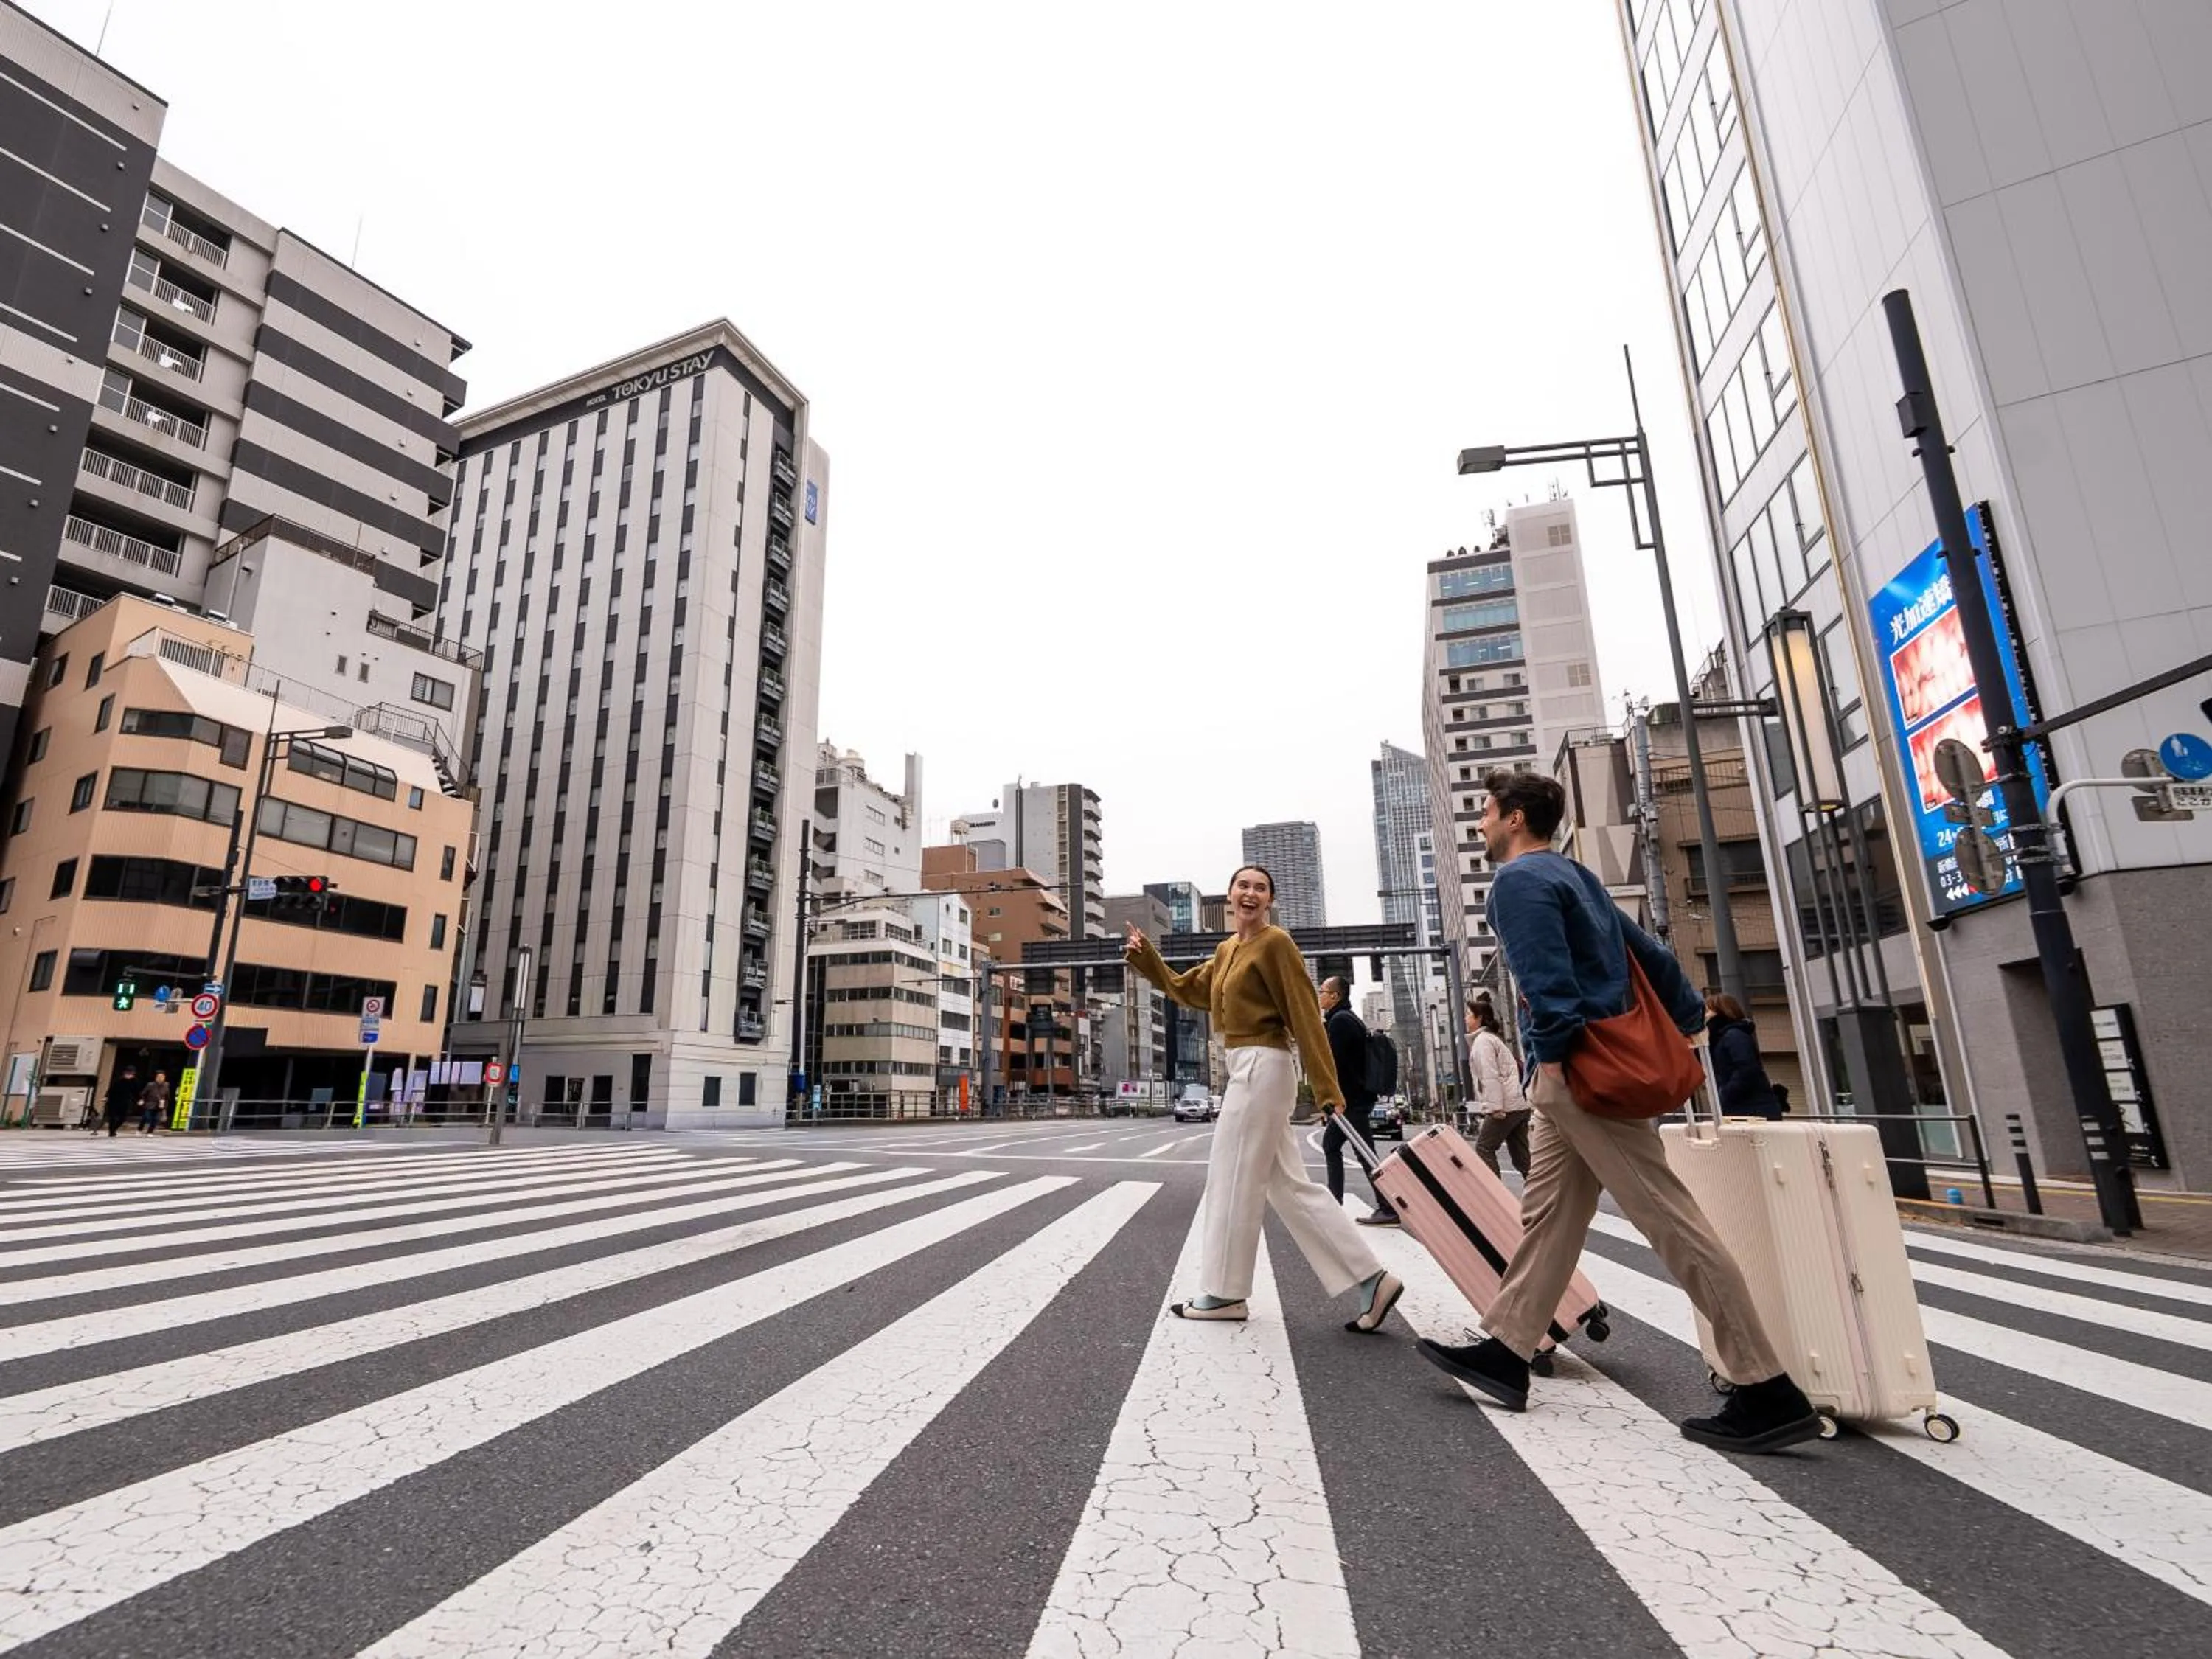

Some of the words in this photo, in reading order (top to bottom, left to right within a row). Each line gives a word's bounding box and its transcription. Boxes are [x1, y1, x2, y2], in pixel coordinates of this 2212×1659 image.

[612, 369, 667, 399] TOKYU
[670, 350, 714, 379] STAY
[197, 1001, 213, 1011] 40
